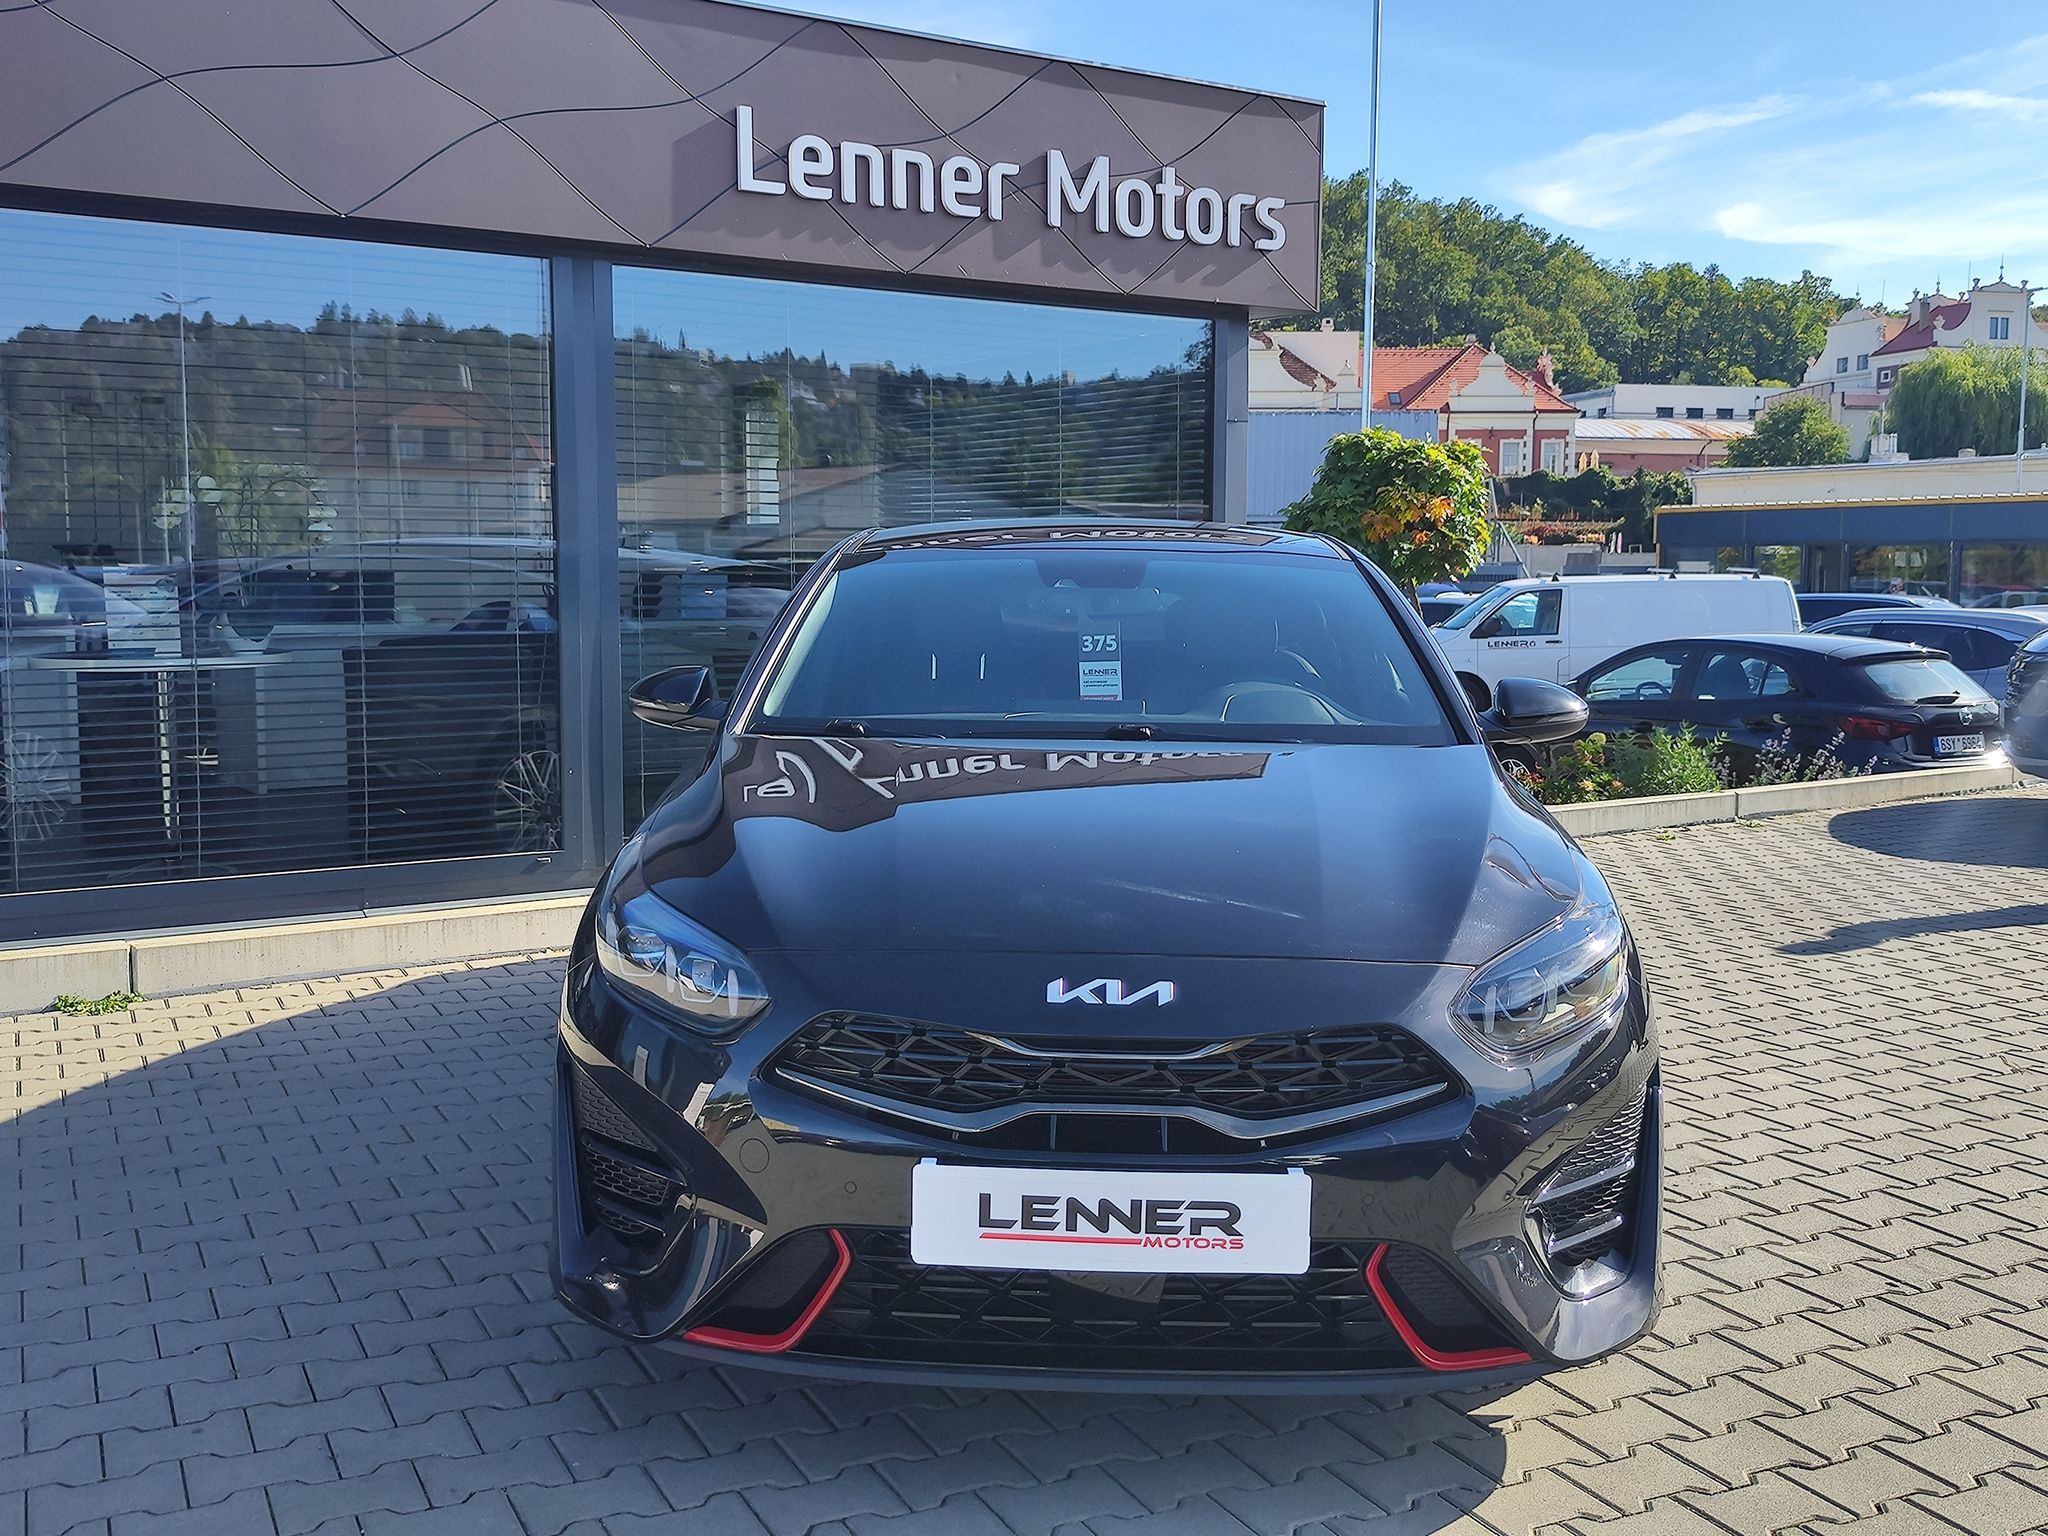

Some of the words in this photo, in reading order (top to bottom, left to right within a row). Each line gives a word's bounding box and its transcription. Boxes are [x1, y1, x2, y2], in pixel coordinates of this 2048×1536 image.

[735, 104, 1021, 222] Lenner
[1045, 148, 1287, 252] Motors
[1081, 634, 1118, 652] 375
[1082, 668, 1118, 676] LENNER
[1047, 977, 1174, 1007] KIA
[978, 1192, 1244, 1236] LENNER
[1142, 1235, 1245, 1250] MOTORS
